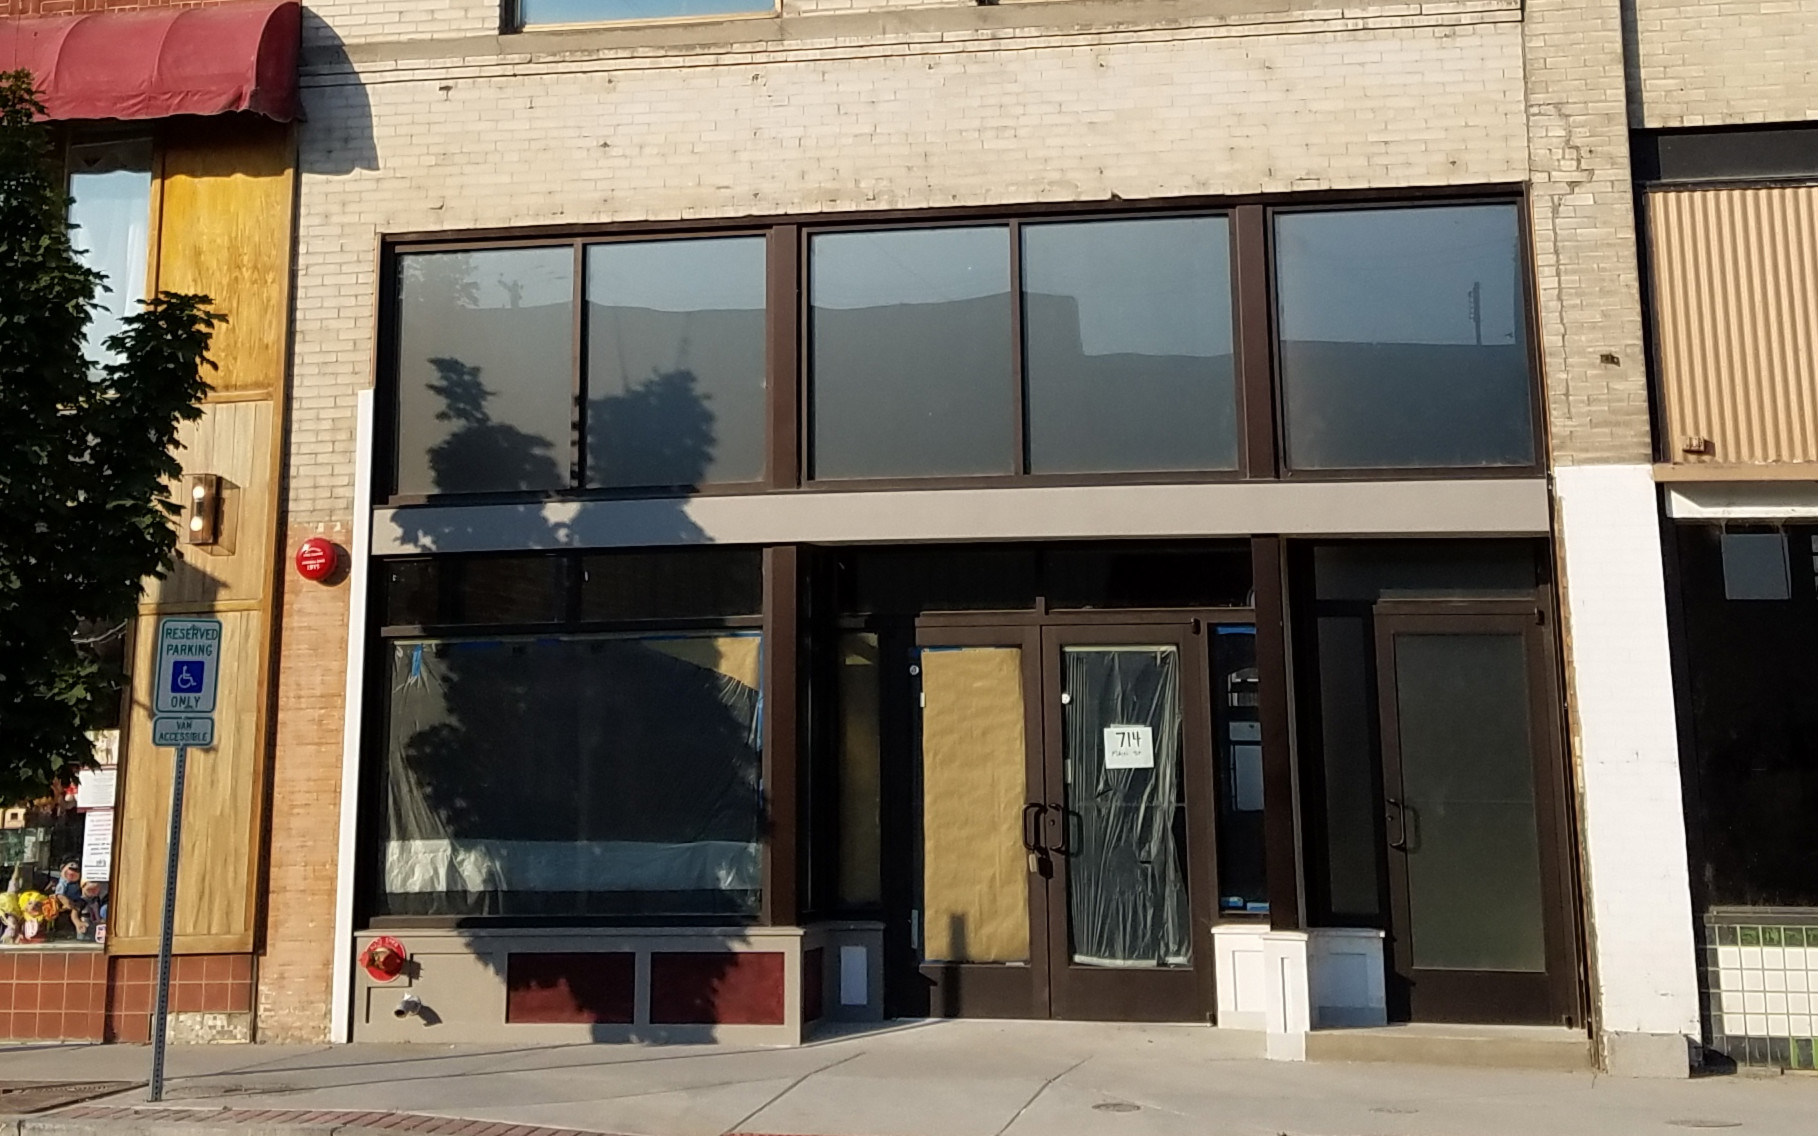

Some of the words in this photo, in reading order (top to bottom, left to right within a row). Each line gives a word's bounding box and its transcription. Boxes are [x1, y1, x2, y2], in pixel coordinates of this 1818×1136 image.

[165, 627, 219, 640] RESERVED
[166, 644, 213, 657] PARKING
[170, 695, 201, 708] ONLY
[176, 720, 193, 730] VAN
[158, 731, 208, 742] ACCESSIBLE
[1115, 730, 1142, 748] 714
